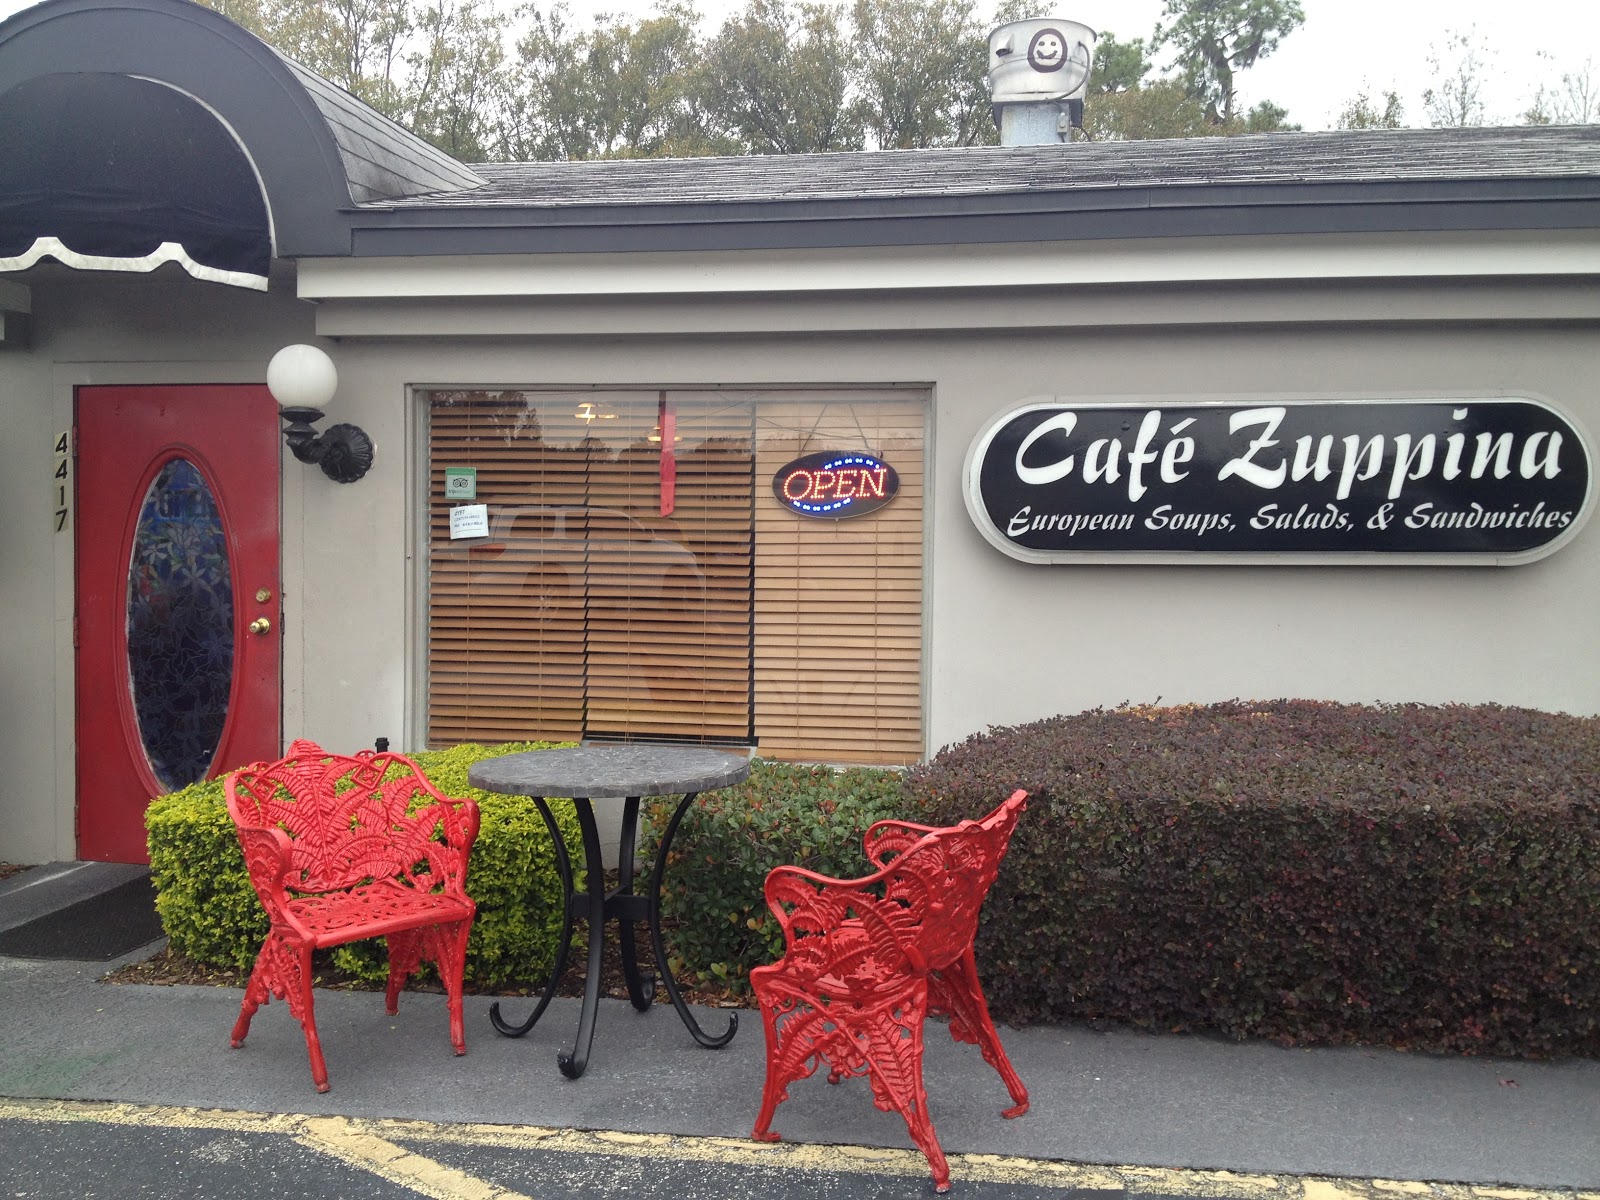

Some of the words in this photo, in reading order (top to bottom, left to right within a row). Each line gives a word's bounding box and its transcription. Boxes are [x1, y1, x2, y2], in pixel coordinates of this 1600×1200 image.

[55, 432, 68, 532] 4417
[783, 469, 888, 501] OPEN
[1016, 412, 1197, 503] Café
[1218, 407, 1562, 500] Zuppina
[1007, 506, 1134, 536] European
[1145, 505, 1236, 535] Soups,
[1250, 503, 1354, 532] Salads,
[1367, 503, 1394, 530] &
[1405, 502, 1572, 529] Sandwiches
